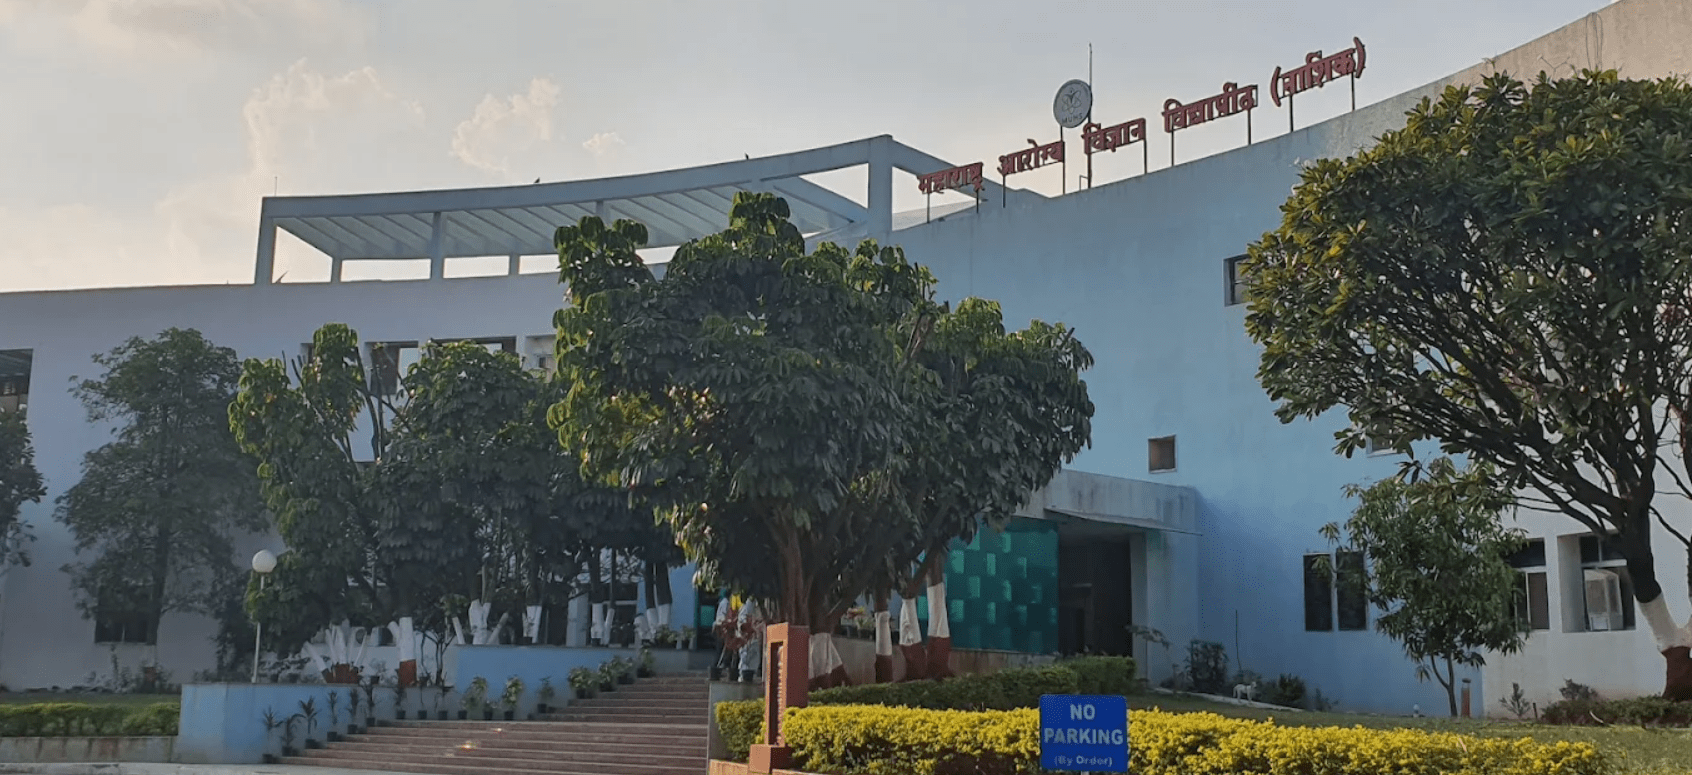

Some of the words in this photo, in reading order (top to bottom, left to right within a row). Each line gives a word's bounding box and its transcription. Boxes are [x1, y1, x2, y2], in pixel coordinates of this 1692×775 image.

[997, 138, 1065, 177] आरोग्य
[1081, 122, 1146, 155] विज्ञान
[1161, 82, 1258, 133] विद्यापीठ
[1270, 36, 1366, 107] (नाशिक)
[1070, 703, 1095, 720] NO
[1044, 727, 1124, 745] PARKING
[1054, 755, 1073, 767] (By
[1076, 755, 1113, 767] Order)
